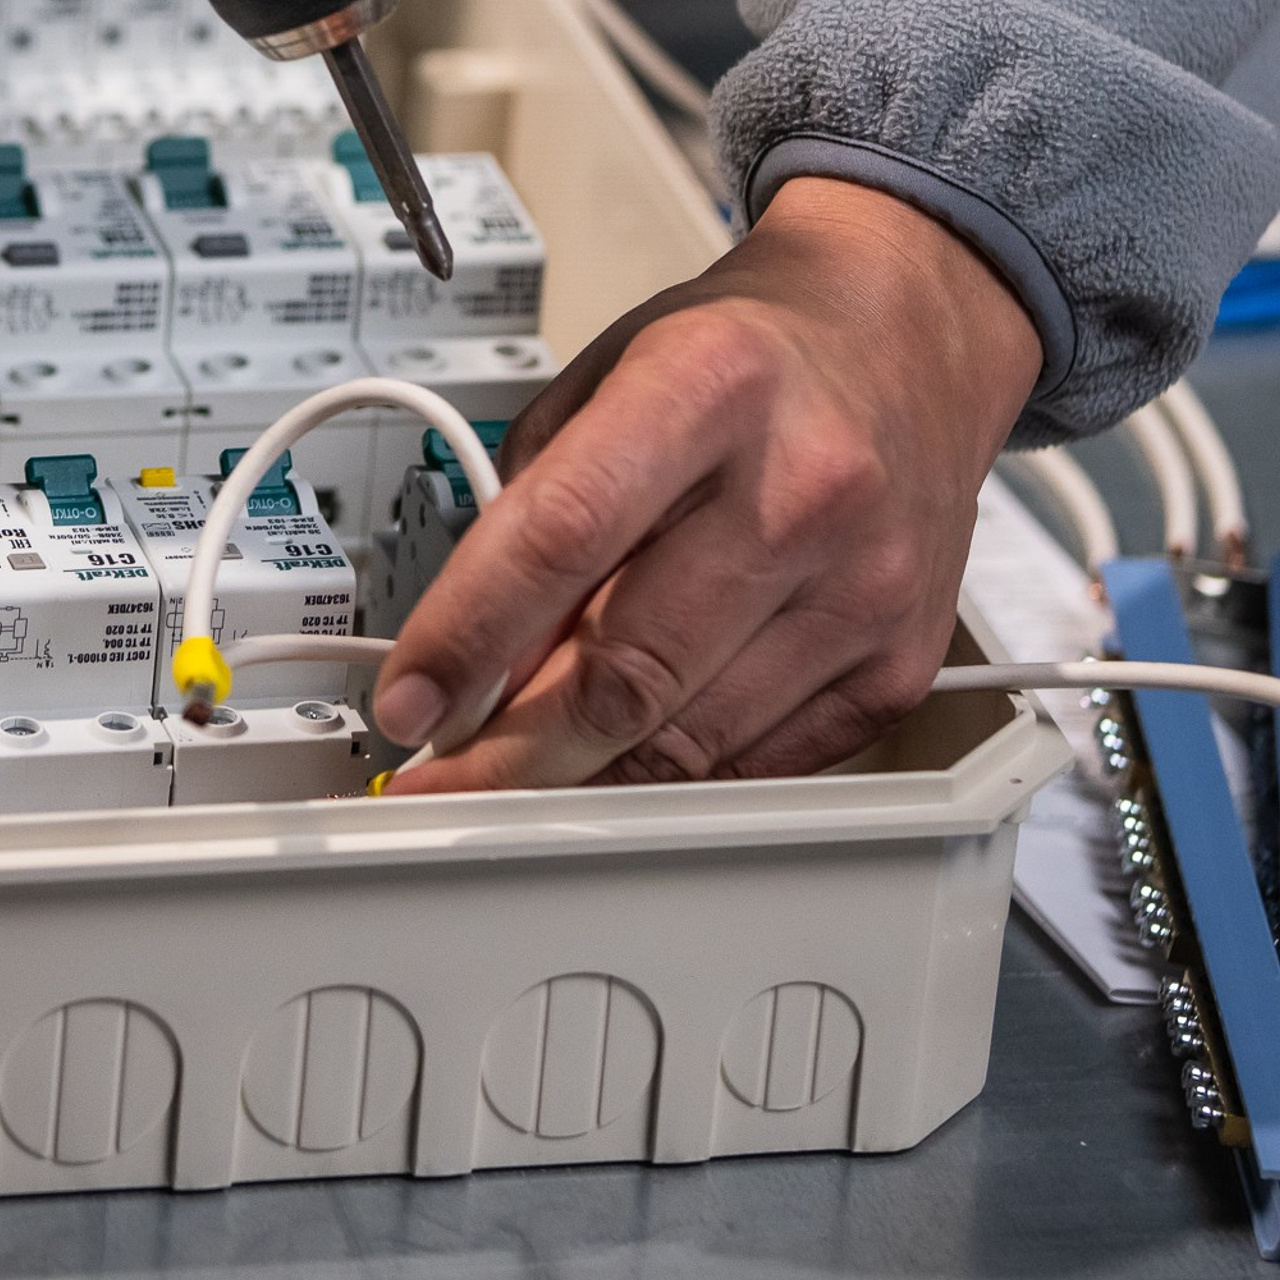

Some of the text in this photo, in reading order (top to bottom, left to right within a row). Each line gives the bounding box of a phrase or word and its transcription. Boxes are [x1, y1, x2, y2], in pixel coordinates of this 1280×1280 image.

[172, 520, 206, 531] oHS
[285, 544, 333, 556] C16
[88, 553, 136, 566] C16
[273, 560, 347, 571] DEKraft
[75, 569, 149, 581] DEKraft
[304, 593, 351, 606] 16347DEK
[108, 602, 154, 615] 16347DEK
[302, 616, 321, 627] 020
[106, 625, 125, 635] 020
